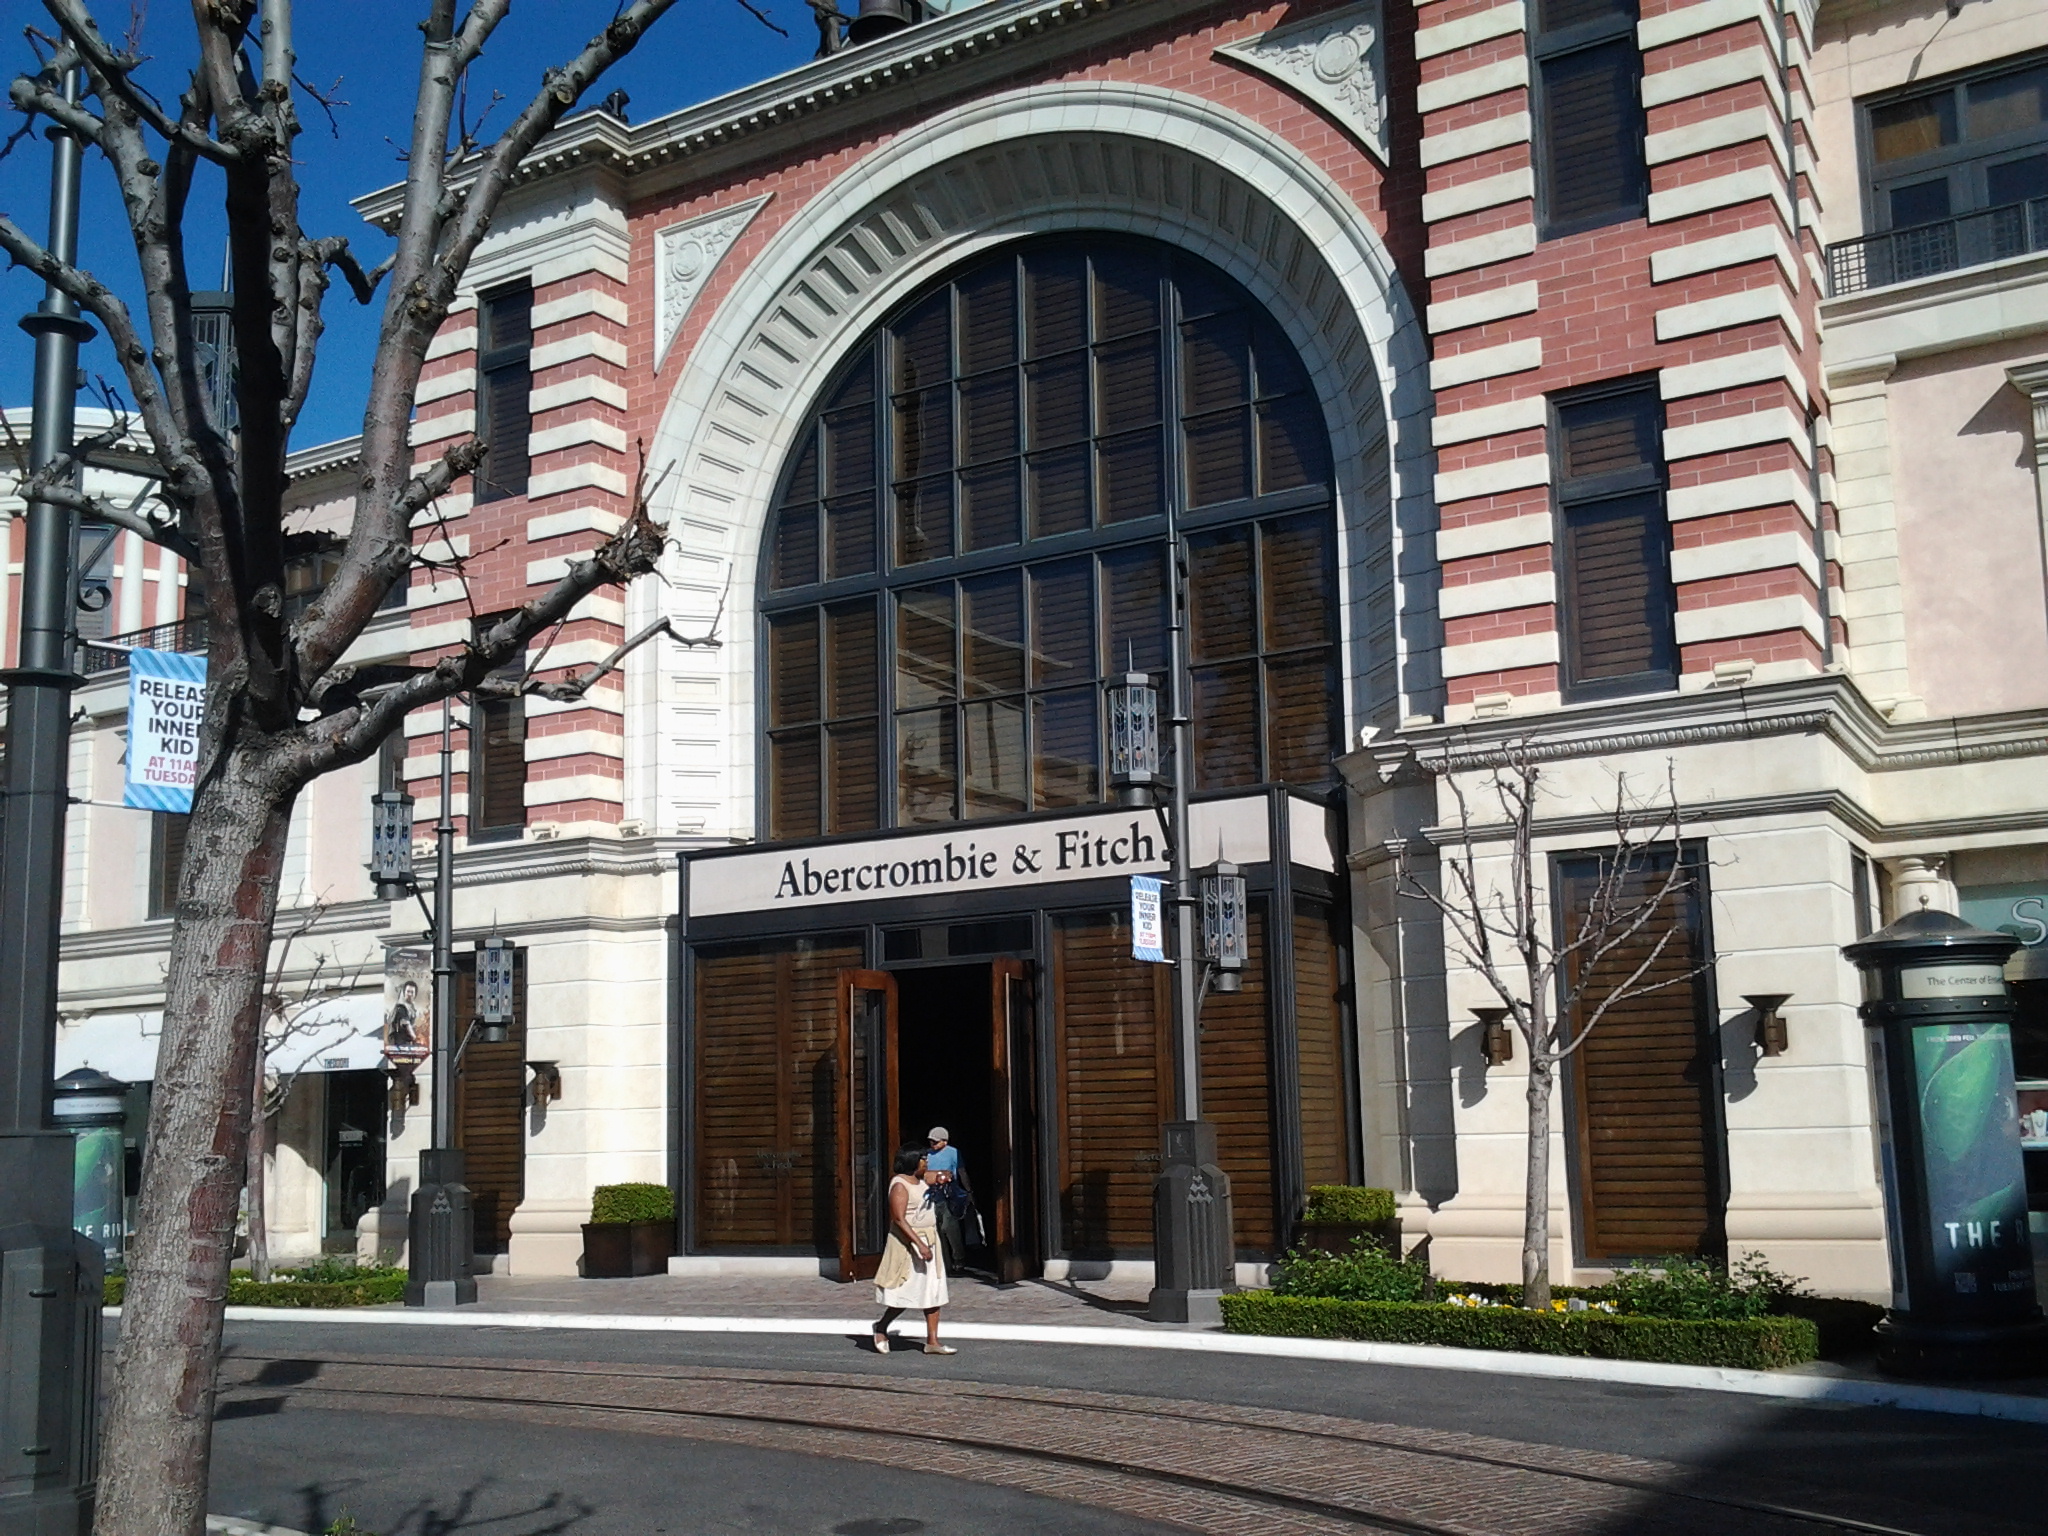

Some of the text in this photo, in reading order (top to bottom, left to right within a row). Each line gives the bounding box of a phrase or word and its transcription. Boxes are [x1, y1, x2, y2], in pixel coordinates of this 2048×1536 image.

[140, 680, 206, 703] RELEAS
[161, 738, 194, 755] KID
[149, 756, 165, 769] AT
[144, 769, 195, 785] TUESDA
[774, 821, 1156, 899] Abercrombie & Fitch
[1139, 902, 1155, 911] YOUR
[1139, 911, 1156, 921] INNER
[2011, 898, 2047, 945] S
[1142, 921, 1153, 930] KID
[1927, 977, 1946, 986] The
[1948, 976, 1977, 986] Center
[1944, 1220, 2002, 1250] THE
